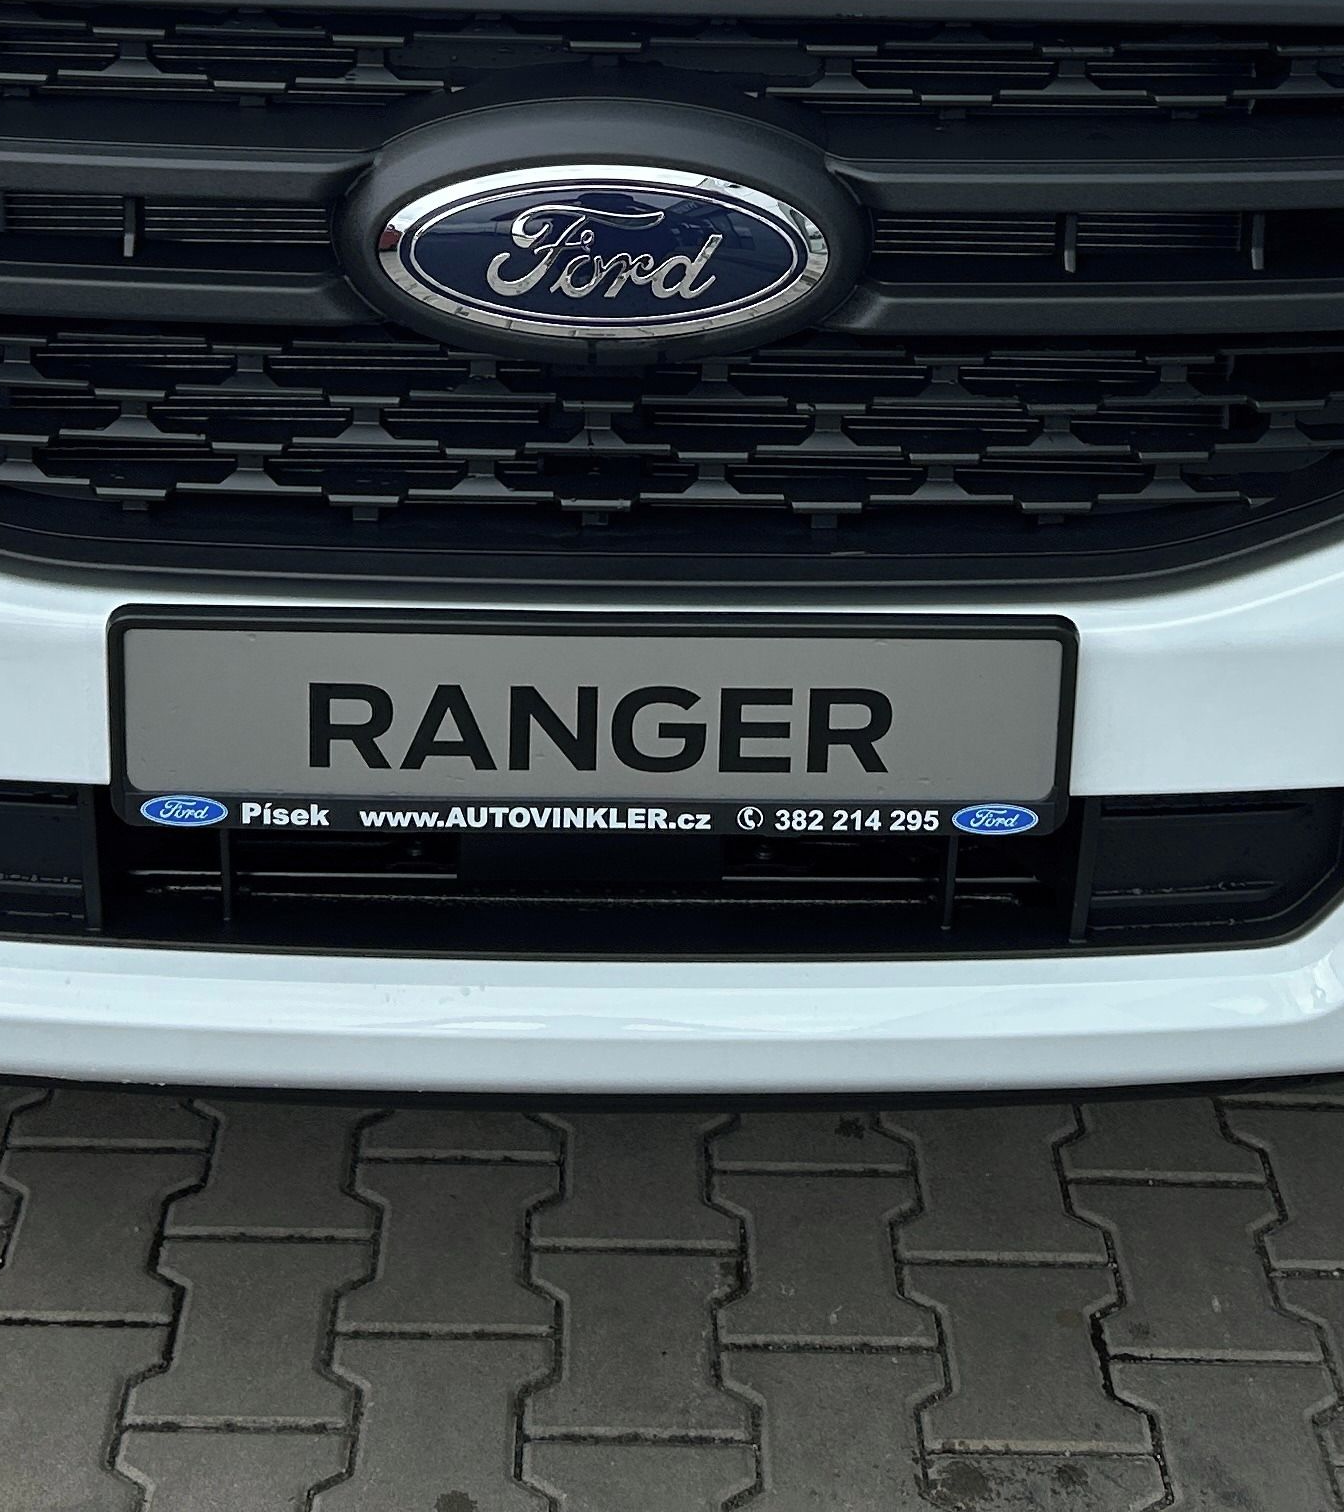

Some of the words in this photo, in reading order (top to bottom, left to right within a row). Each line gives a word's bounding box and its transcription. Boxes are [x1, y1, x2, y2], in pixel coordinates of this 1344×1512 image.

[486, 205, 723, 300] Ford
[308, 682, 895, 773] RANGER
[159, 799, 209, 821] Ford
[240, 802, 330, 826] Písek
[359, 806, 712, 830] www.AUTOVINKLER.cz
[774, 809, 824, 831] 382
[832, 809, 882, 831] 214
[889, 810, 940, 831] 295
[970, 807, 1019, 829] Ford
